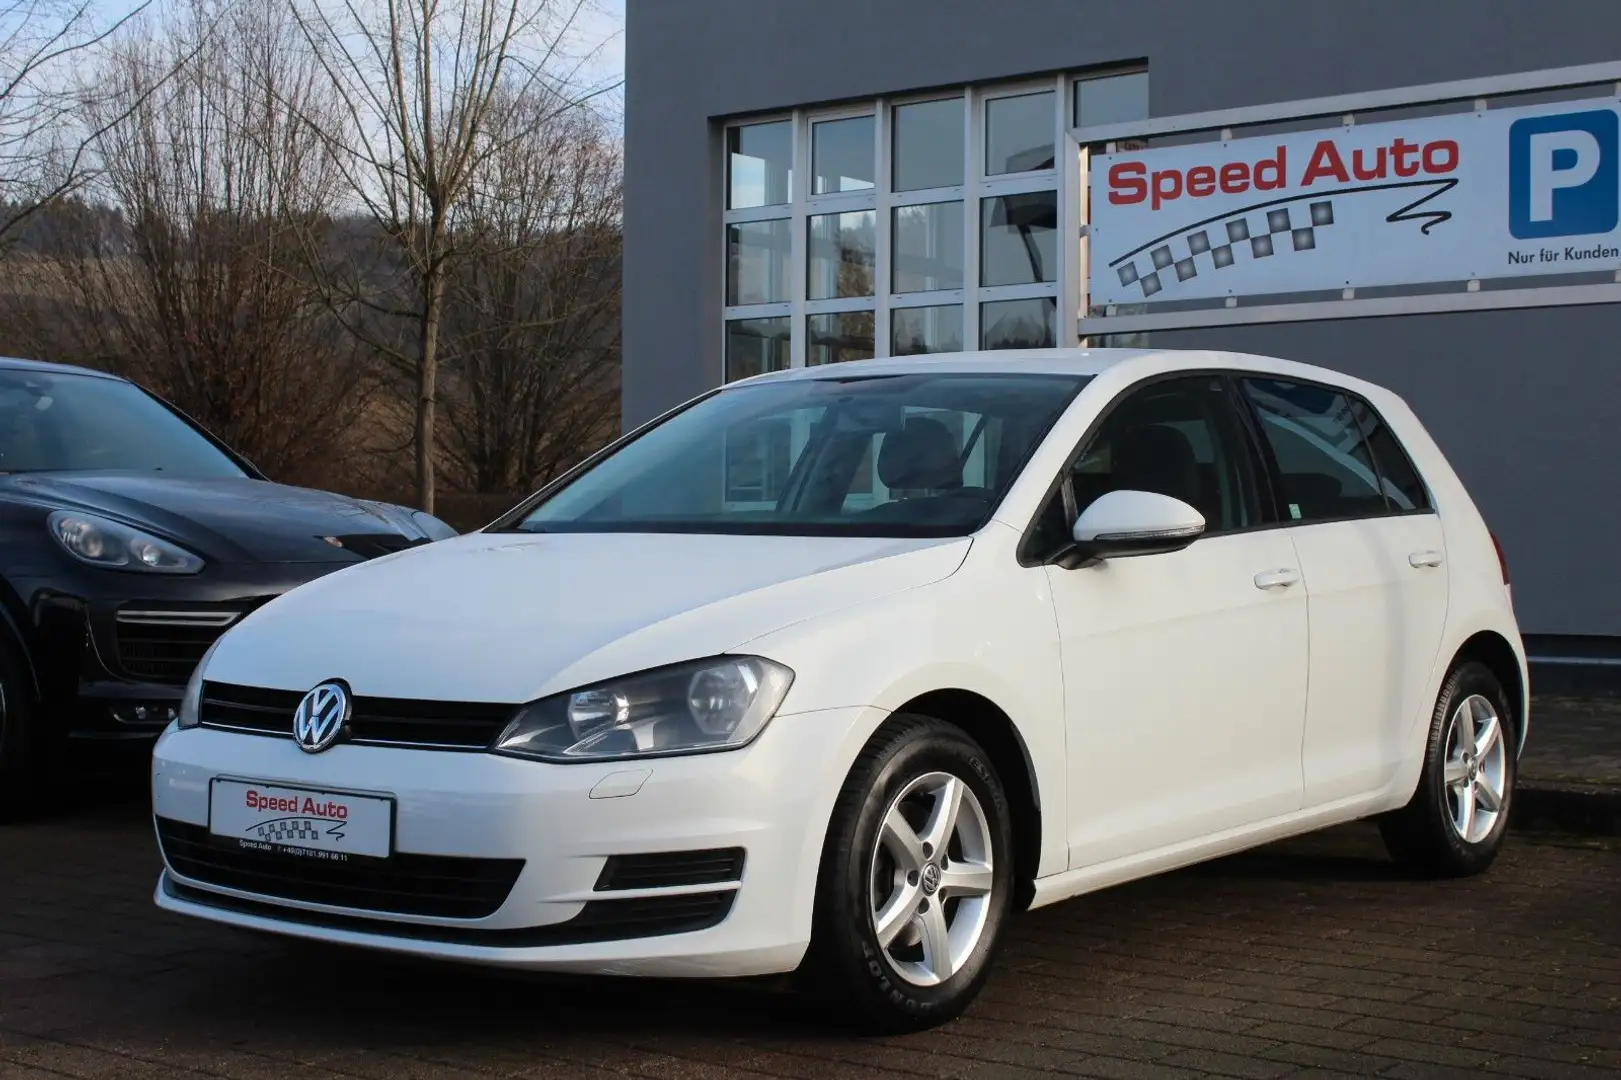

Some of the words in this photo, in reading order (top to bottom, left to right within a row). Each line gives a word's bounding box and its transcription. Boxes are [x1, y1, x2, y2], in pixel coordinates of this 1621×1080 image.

[1108, 145, 1286, 210] Speed
[1299, 137, 1459, 187] Auto
[1529, 129, 1601, 222] P
[1508, 251, 1535, 264] Nur
[1540, 247, 1559, 262] für
[1564, 244, 1619, 260] Kunden
[246, 790, 298, 812] Speed
[301, 797, 348, 819] Auto
[239, 839, 257, 849] Speed
[258, 843, 272, 851] Auto
